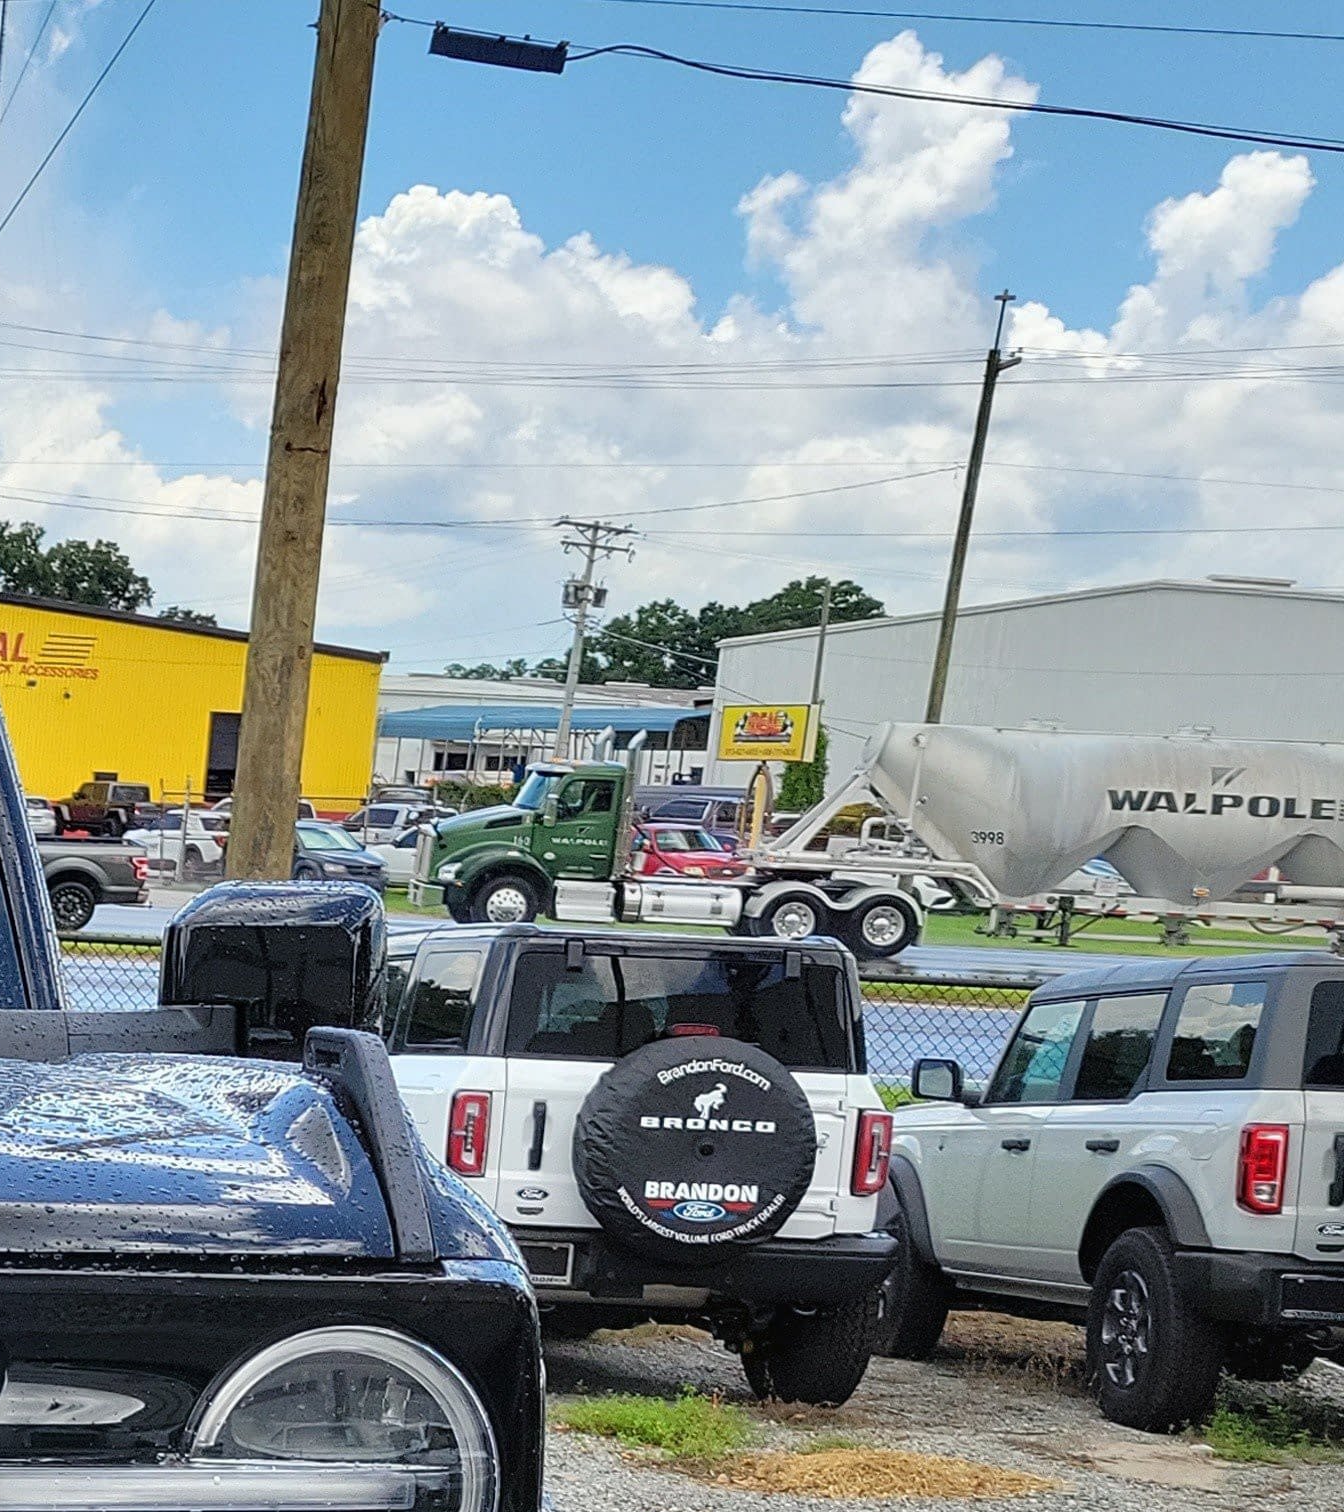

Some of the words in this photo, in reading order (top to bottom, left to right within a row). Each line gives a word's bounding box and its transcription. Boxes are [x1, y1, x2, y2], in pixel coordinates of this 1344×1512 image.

[19, 664, 100, 680] ACCESSORIES
[1108, 789, 1334, 820] WALPOLE
[971, 830, 1004, 845] 3998
[657, 1059, 771, 1091] BrandonFord.com
[640, 1116, 776, 1133] BRONCO
[645, 1181, 758, 1203] BRANDON
[733, 1216, 762, 1237] TRUCK
[758, 1194, 786, 1223] DEALER
